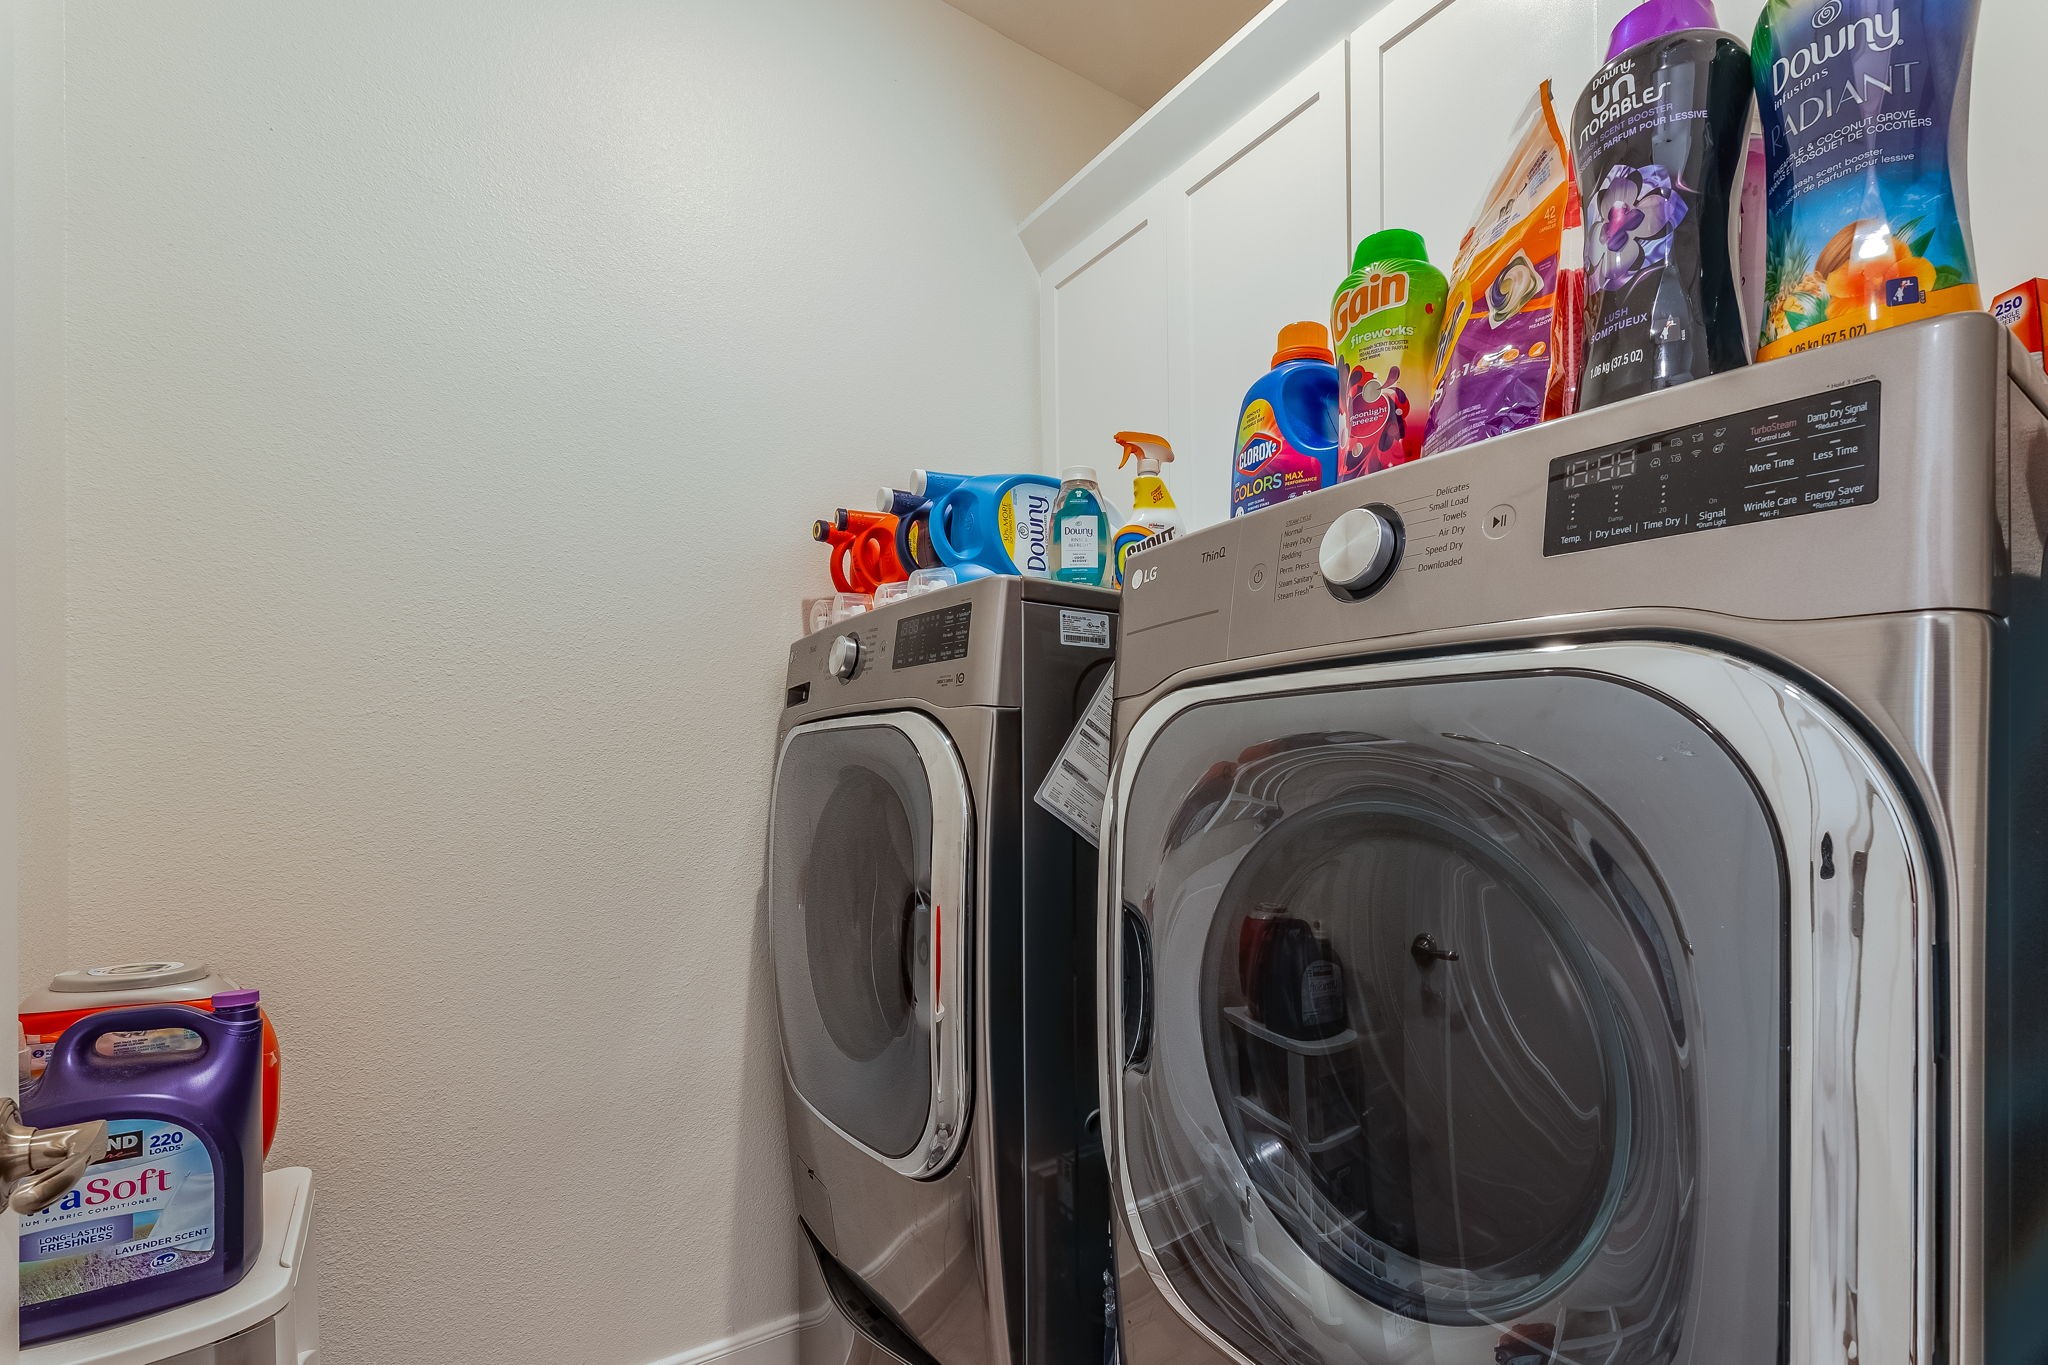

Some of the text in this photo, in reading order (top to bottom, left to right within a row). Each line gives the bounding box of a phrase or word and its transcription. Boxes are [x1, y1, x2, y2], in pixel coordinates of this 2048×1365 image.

[1772, 8, 1900, 96] Downy
[1592, 59, 1633, 91] Downy
[1774, 67, 1829, 111] infusions
[1579, 82, 1668, 150] STOPABLES
[1771, 60, 1920, 158] RADIANT
[1599, 121, 1626, 142] SCENT
[1627, 102, 1674, 126] BOOSTER
[1806, 142, 1815, 152] &
[1816, 115, 1874, 147] COCONUT
[1876, 109, 1917, 124] GROVE
[1593, 109, 1709, 160] DE PARFUM POUR LESSIVE
[1795, 137, 1844, 168] BOSQUET
[1847, 129, 1864, 143] DE
[1866, 117, 1933, 135] COCOTIERS
[1816, 162, 1842, 178] scent
[1844, 147, 1884, 166] booster
[1802, 153, 1915, 194] de parfum pour lessive
[1544, 206, 1556, 220] 42
[1334, 273, 1406, 342] Gain
[1995, 296, 2022, 317] 250
[1604, 306, 1629, 325] LUSH
[2003, 315, 2021, 325] EETS
[1590, 312, 1648, 344] SOMPTUEUX
[1351, 325, 1414, 349] fireworks
[1821, 329, 1846, 346] (375
[1590, 348, 1644, 379] 1.06 kg (37.5 OZ)
[1807, 402, 1868, 423] Damp Dry Signal
[1840, 416, 1857, 425] Static
[1352, 416, 1379, 427] breeze
[1750, 420, 1797, 436] TurboSteam
[1778, 430, 1792, 438] Lock
[1813, 445, 1859, 461] Less Time
[1749, 458, 1795, 473] More Time
[1284, 476, 1317, 486] PERFORMANCE
[1285, 471, 1304, 481] MAX
[1234, 473, 1282, 503] COLORS
[1436, 483, 1470, 496] Delicates
[1805, 485, 1864, 502] Energy Saver
[1429, 495, 1469, 512] Small Load
[1744, 496, 1798, 512] Wrinkle Care
[1839, 497, 1854, 505] Start
[1001, 502, 1009, 527] MORE
[1443, 510, 1467, 522] Towels
[1713, 518, 1727, 527] Light
[1027, 495, 1049, 572] Downy
[1064, 527, 1093, 537] Downy
[1284, 526, 1303, 537] Normal
[1438, 526, 1465, 537] Air Dry
[1561, 508, 1726, 545] Temp. Dry Level Time Dry Signal
[1283, 536, 1312, 549] Heavy Duty
[1425, 541, 1463, 556] Speed Dry
[1201, 546, 1226, 563] ThinQ
[1281, 550, 1302, 561] Bedding
[1295, 562, 1310, 572] Press
[1418, 556, 1463, 572] Downloaded
[1143, 566, 1158, 583] LG
[1278, 579, 1293, 588] Steam
[1277, 591, 1293, 600] Steam
[150, 1131, 184, 1148] 220
[45, 1196, 157, 1223] FABRIC CONDITIONER
[39, 1224, 114, 1246] LONG-LASTING
[40, 1232, 113, 1253] FRESHNESS
[115, 1227, 209, 1256] LAVENDER SCENT
